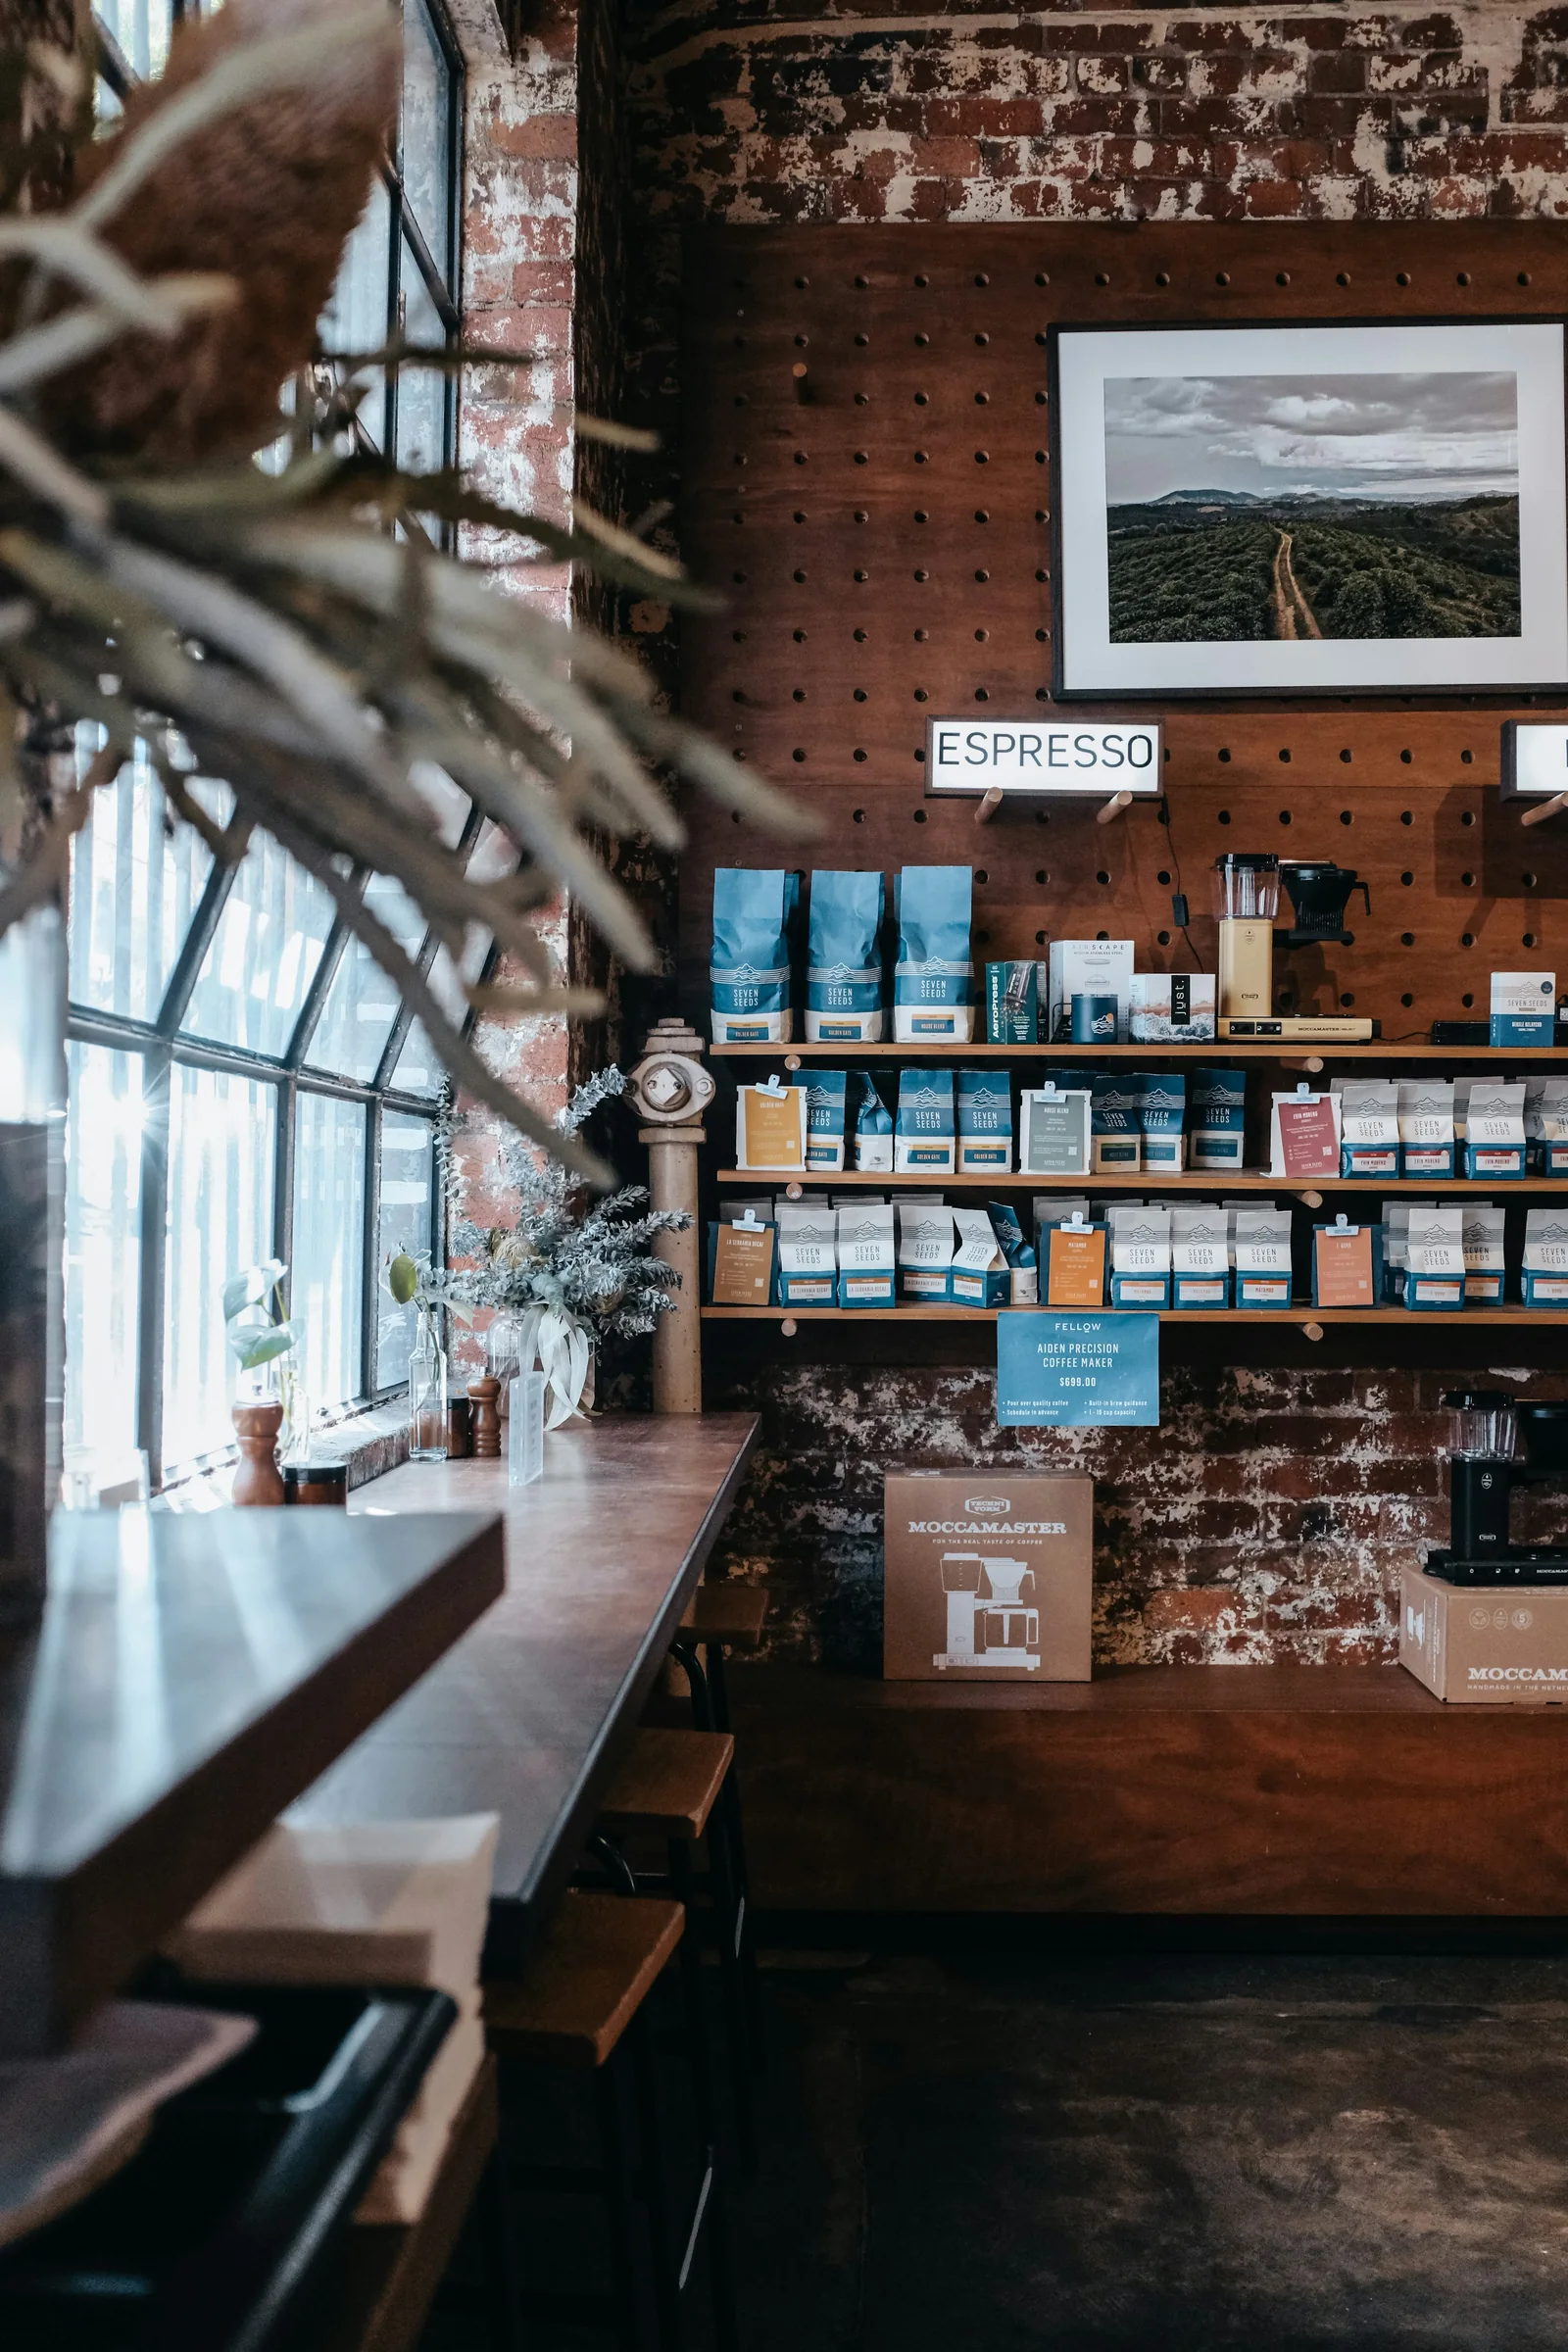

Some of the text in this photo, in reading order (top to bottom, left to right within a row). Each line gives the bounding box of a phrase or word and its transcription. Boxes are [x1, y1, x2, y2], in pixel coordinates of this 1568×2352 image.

[938, 731, 1152, 768] ESPRESSO
[921, 980, 946, 989] SEVEN
[734, 989, 759, 998] SEVEN
[828, 988, 853, 997] SEVEN
[734, 998, 759, 1006] SEEDS
[828, 997, 853, 1005] SEEDS
[1175, 980, 1187, 1015] just.
[916, 1111, 941, 1120] SEVEN
[973, 1111, 998, 1120] SEVEN
[970, 1246, 988, 1255] SEVEN
[1055, 1323, 1102, 1333] FELLOW
[1037, 1344, 1119, 1353] AIDEN PRECISION
[1043, 1358, 1113, 1368] COFFEE MAKER
[1059, 1377, 1096, 1387] $699.00
[908, 1521, 1067, 1534] MOCCAMASTER
[1468, 1667, 1568, 1681] MOCCAM
